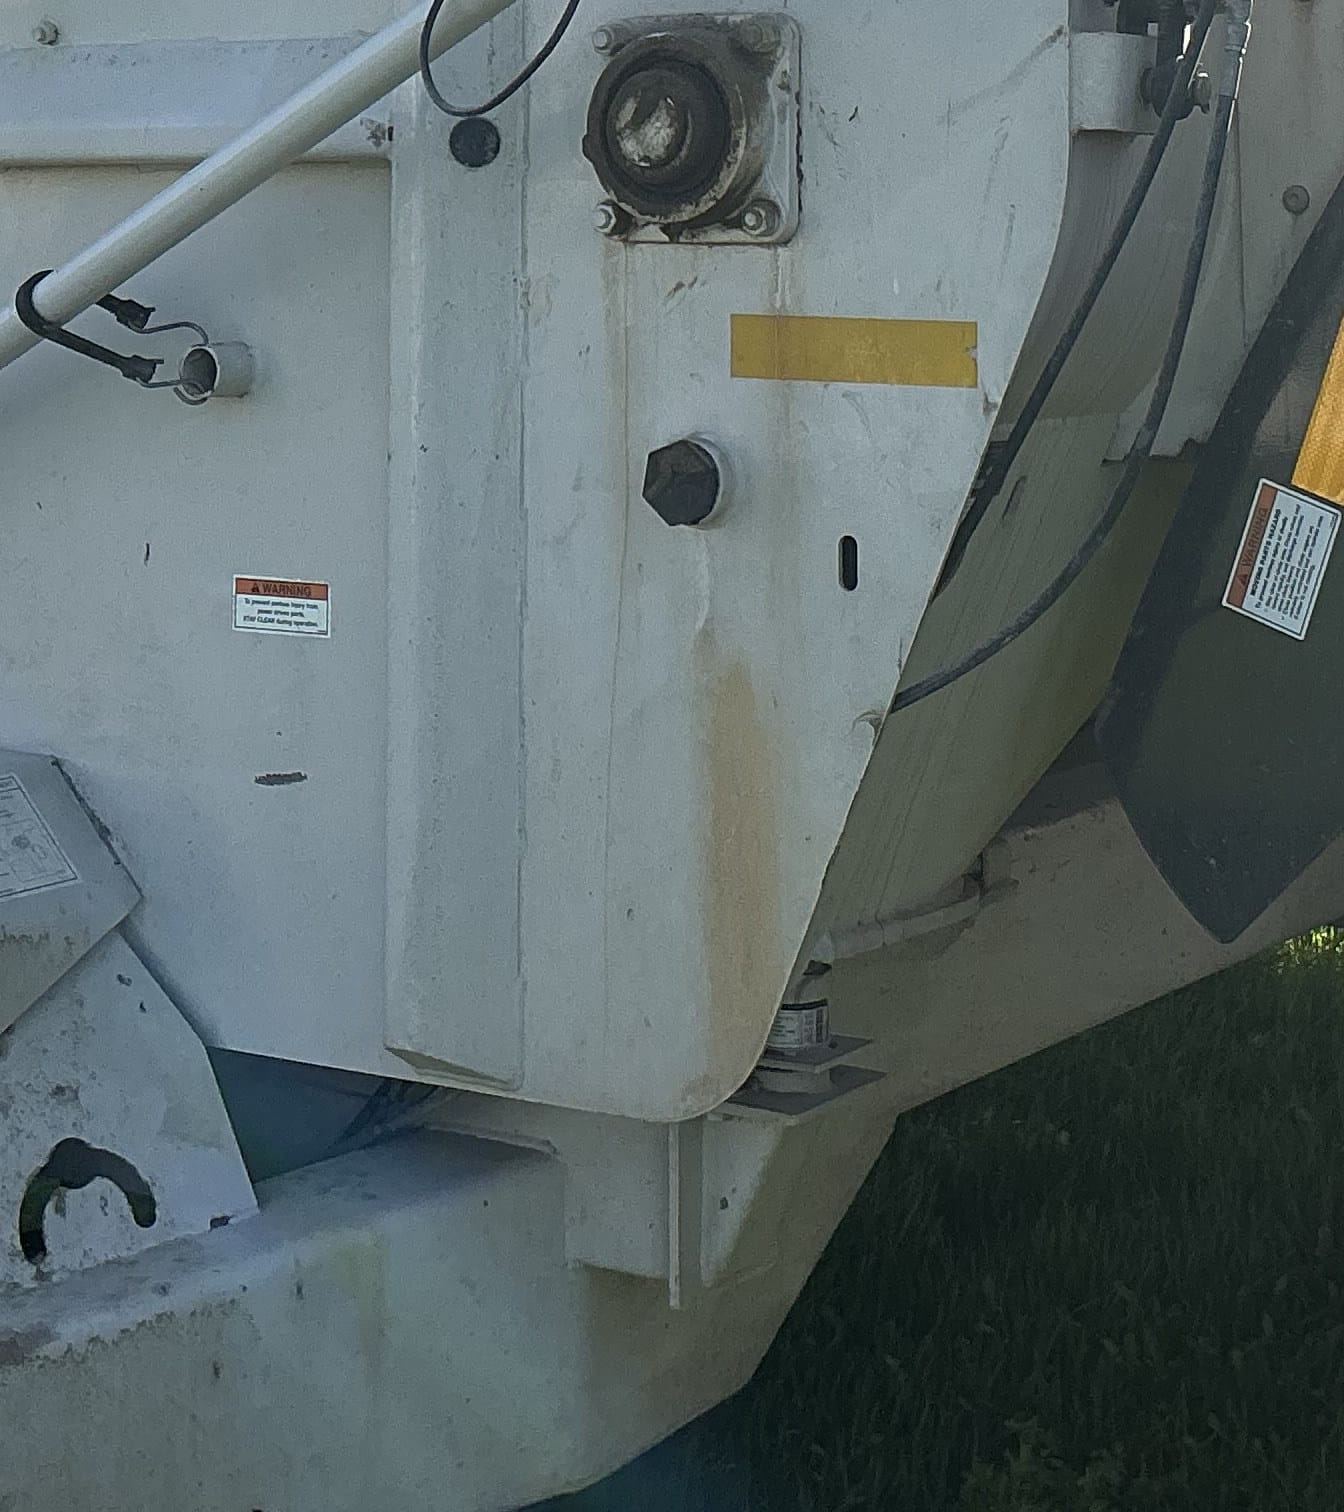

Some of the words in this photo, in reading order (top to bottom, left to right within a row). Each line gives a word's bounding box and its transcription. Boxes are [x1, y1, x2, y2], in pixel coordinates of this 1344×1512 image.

[1242, 507, 1269, 567] WARNING
[1259, 540, 1272, 566] PARTS
[1268, 508, 1281, 540] HAZARD
[262, 583, 312, 597] WARNING
